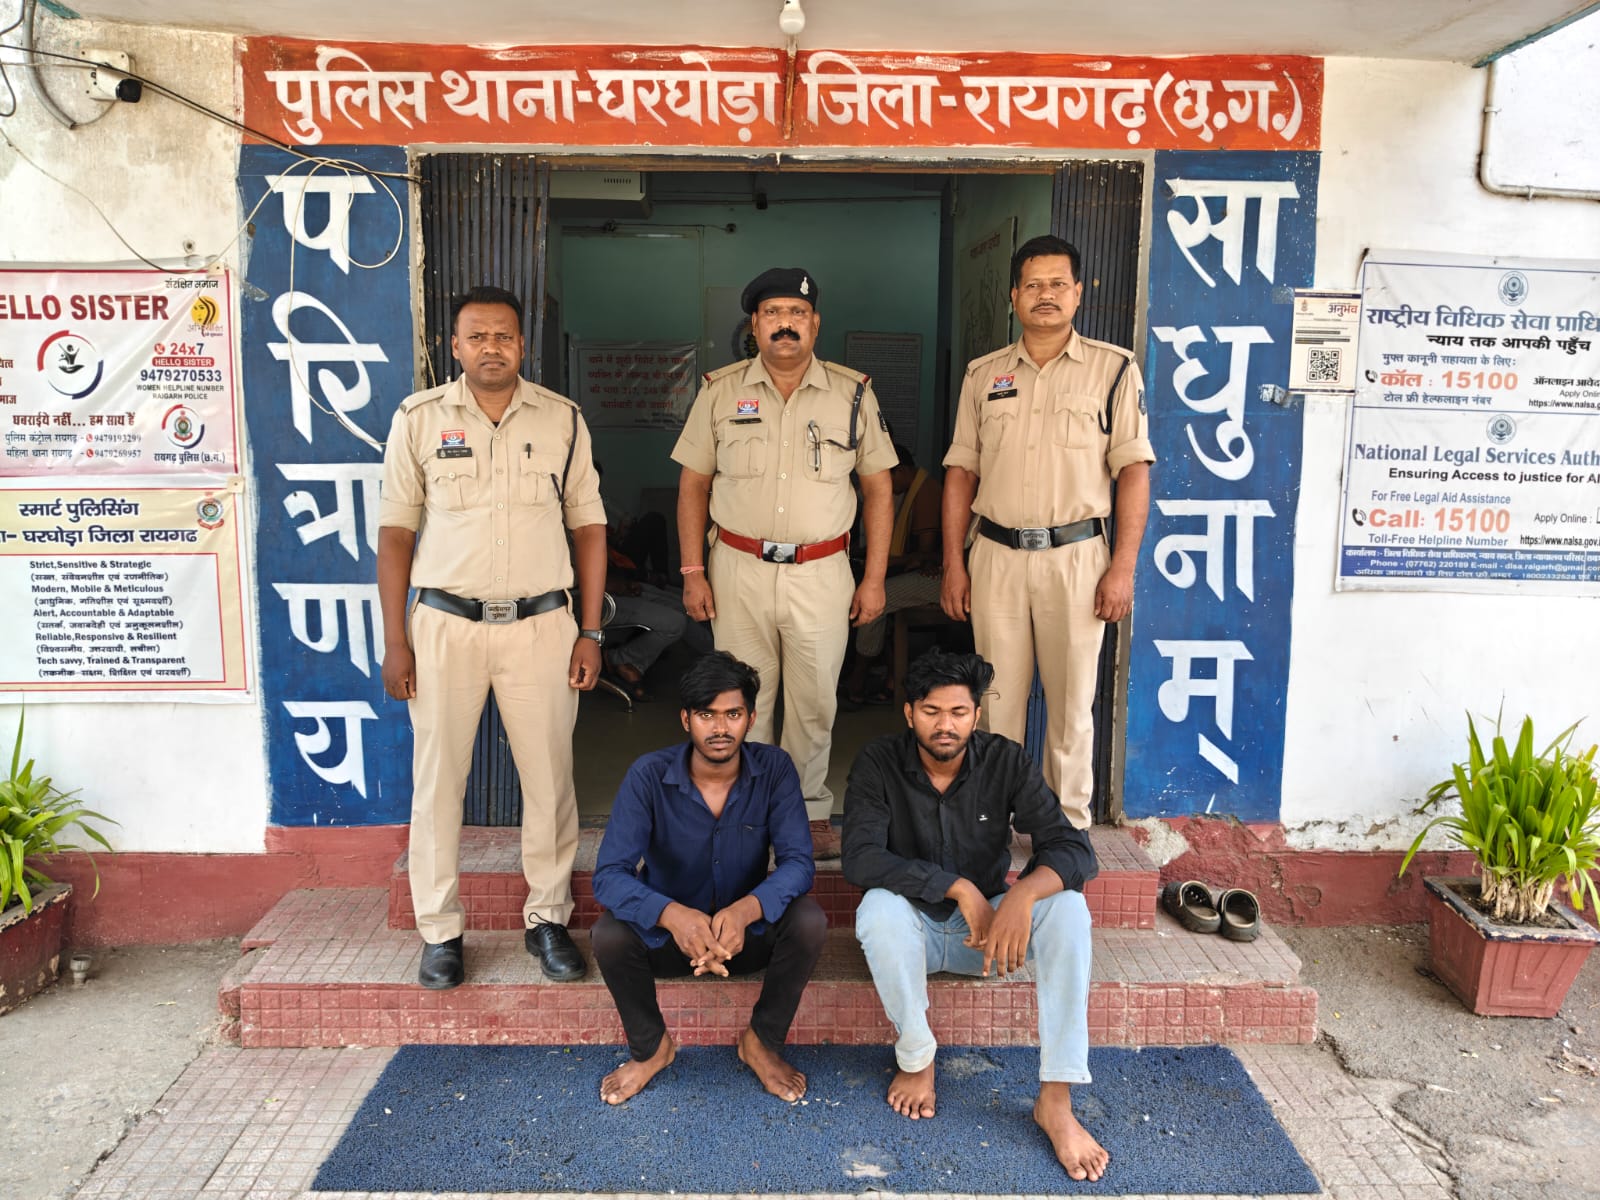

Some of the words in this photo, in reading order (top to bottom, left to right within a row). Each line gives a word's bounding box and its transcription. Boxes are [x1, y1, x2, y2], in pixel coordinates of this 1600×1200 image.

[264, 44, 435, 145] पुलिस
[0, 294, 61, 320] ELLO
[70, 294, 169, 320] SISTER
[1328, 304, 1358, 317] अनुभव
[1366, 304, 1431, 328] राष्ट्रीय
[1435, 305, 1505, 328] विधिक
[1510, 309, 1551, 330] सेवा
[170, 342, 204, 355] 24x7
[1426, 335, 1464, 346] न्याय
[1469, 336, 1497, 348] तक
[1502, 336, 1551, 349] आपकी
[1556, 336, 1591, 355] पहुँच
[154, 358, 181, 367] HELLO
[183, 358, 212, 367] SISTER
[1382, 353, 1403, 365] मुफ्त
[1407, 352, 1437, 366] कानूनी
[1481, 355, 1490, 365] के
[140, 369, 222, 382] 9479270533
[1380, 369, 1423, 387] कॉल
[1442, 370, 1518, 390] 15100
[1533, 375, 1574, 387] ऑनलाइन
[136, 384, 160, 392] WOMEN
[163, 384, 194, 392] HELPLINE
[1559, 390, 1580, 399] Apply
[1384, 391, 1403, 402] टोल
[1406, 391, 1419, 403] फ्री
[1472, 395, 1492, 405] नंबर
[89, 415, 103, 425] हम
[106, 415, 125, 425] साथ
[126, 412, 135, 425] हैं
[5, 431, 26, 445] पुलिस
[6, 446, 28, 458] महिला
[32, 449, 48, 458] थाना
[179, 451, 199, 464] पुलिस
[1355, 443, 1427, 461] National
[1434, 446, 1480, 466] Legal
[1486, 447, 1556, 465] Services
[1389, 467, 1448, 482] Ensuring
[1452, 469, 1499, 480] Access
[1503, 472, 1516, 481] to
[1519, 472, 1562, 484] justice
[1566, 473, 1584, 483] for
[1371, 490, 1387, 501] For
[1390, 491, 1411, 502] Free
[1413, 491, 1439, 505] Legal
[1442, 492, 1458, 503] Aid
[1460, 493, 1511, 504] Assistance
[19, 498, 62, 516] स्मार्ट
[66, 497, 139, 522] पुलिसिंग
[1434, 507, 1510, 533] 15100
[1534, 513, 1558, 525] Apply
[1560, 513, 1587, 524] Online
[88, 525, 134, 543] जिला
[1368, 534, 1415, 545] Toll-Free
[1418, 535, 1462, 547] Helpline
[1465, 536, 1508, 546] Number
[109, 561, 152, 569] Strategic
[1471, 561, 1497, 569] E-mail
[32, 585, 69, 594] Modern,
[71, 585, 101, 593] Mobile
[33, 609, 58, 618] Alert,
[60, 609, 116, 617] Accountable
[128, 609, 175, 618] Adaptable
[131, 657, 185, 665] Transparent
